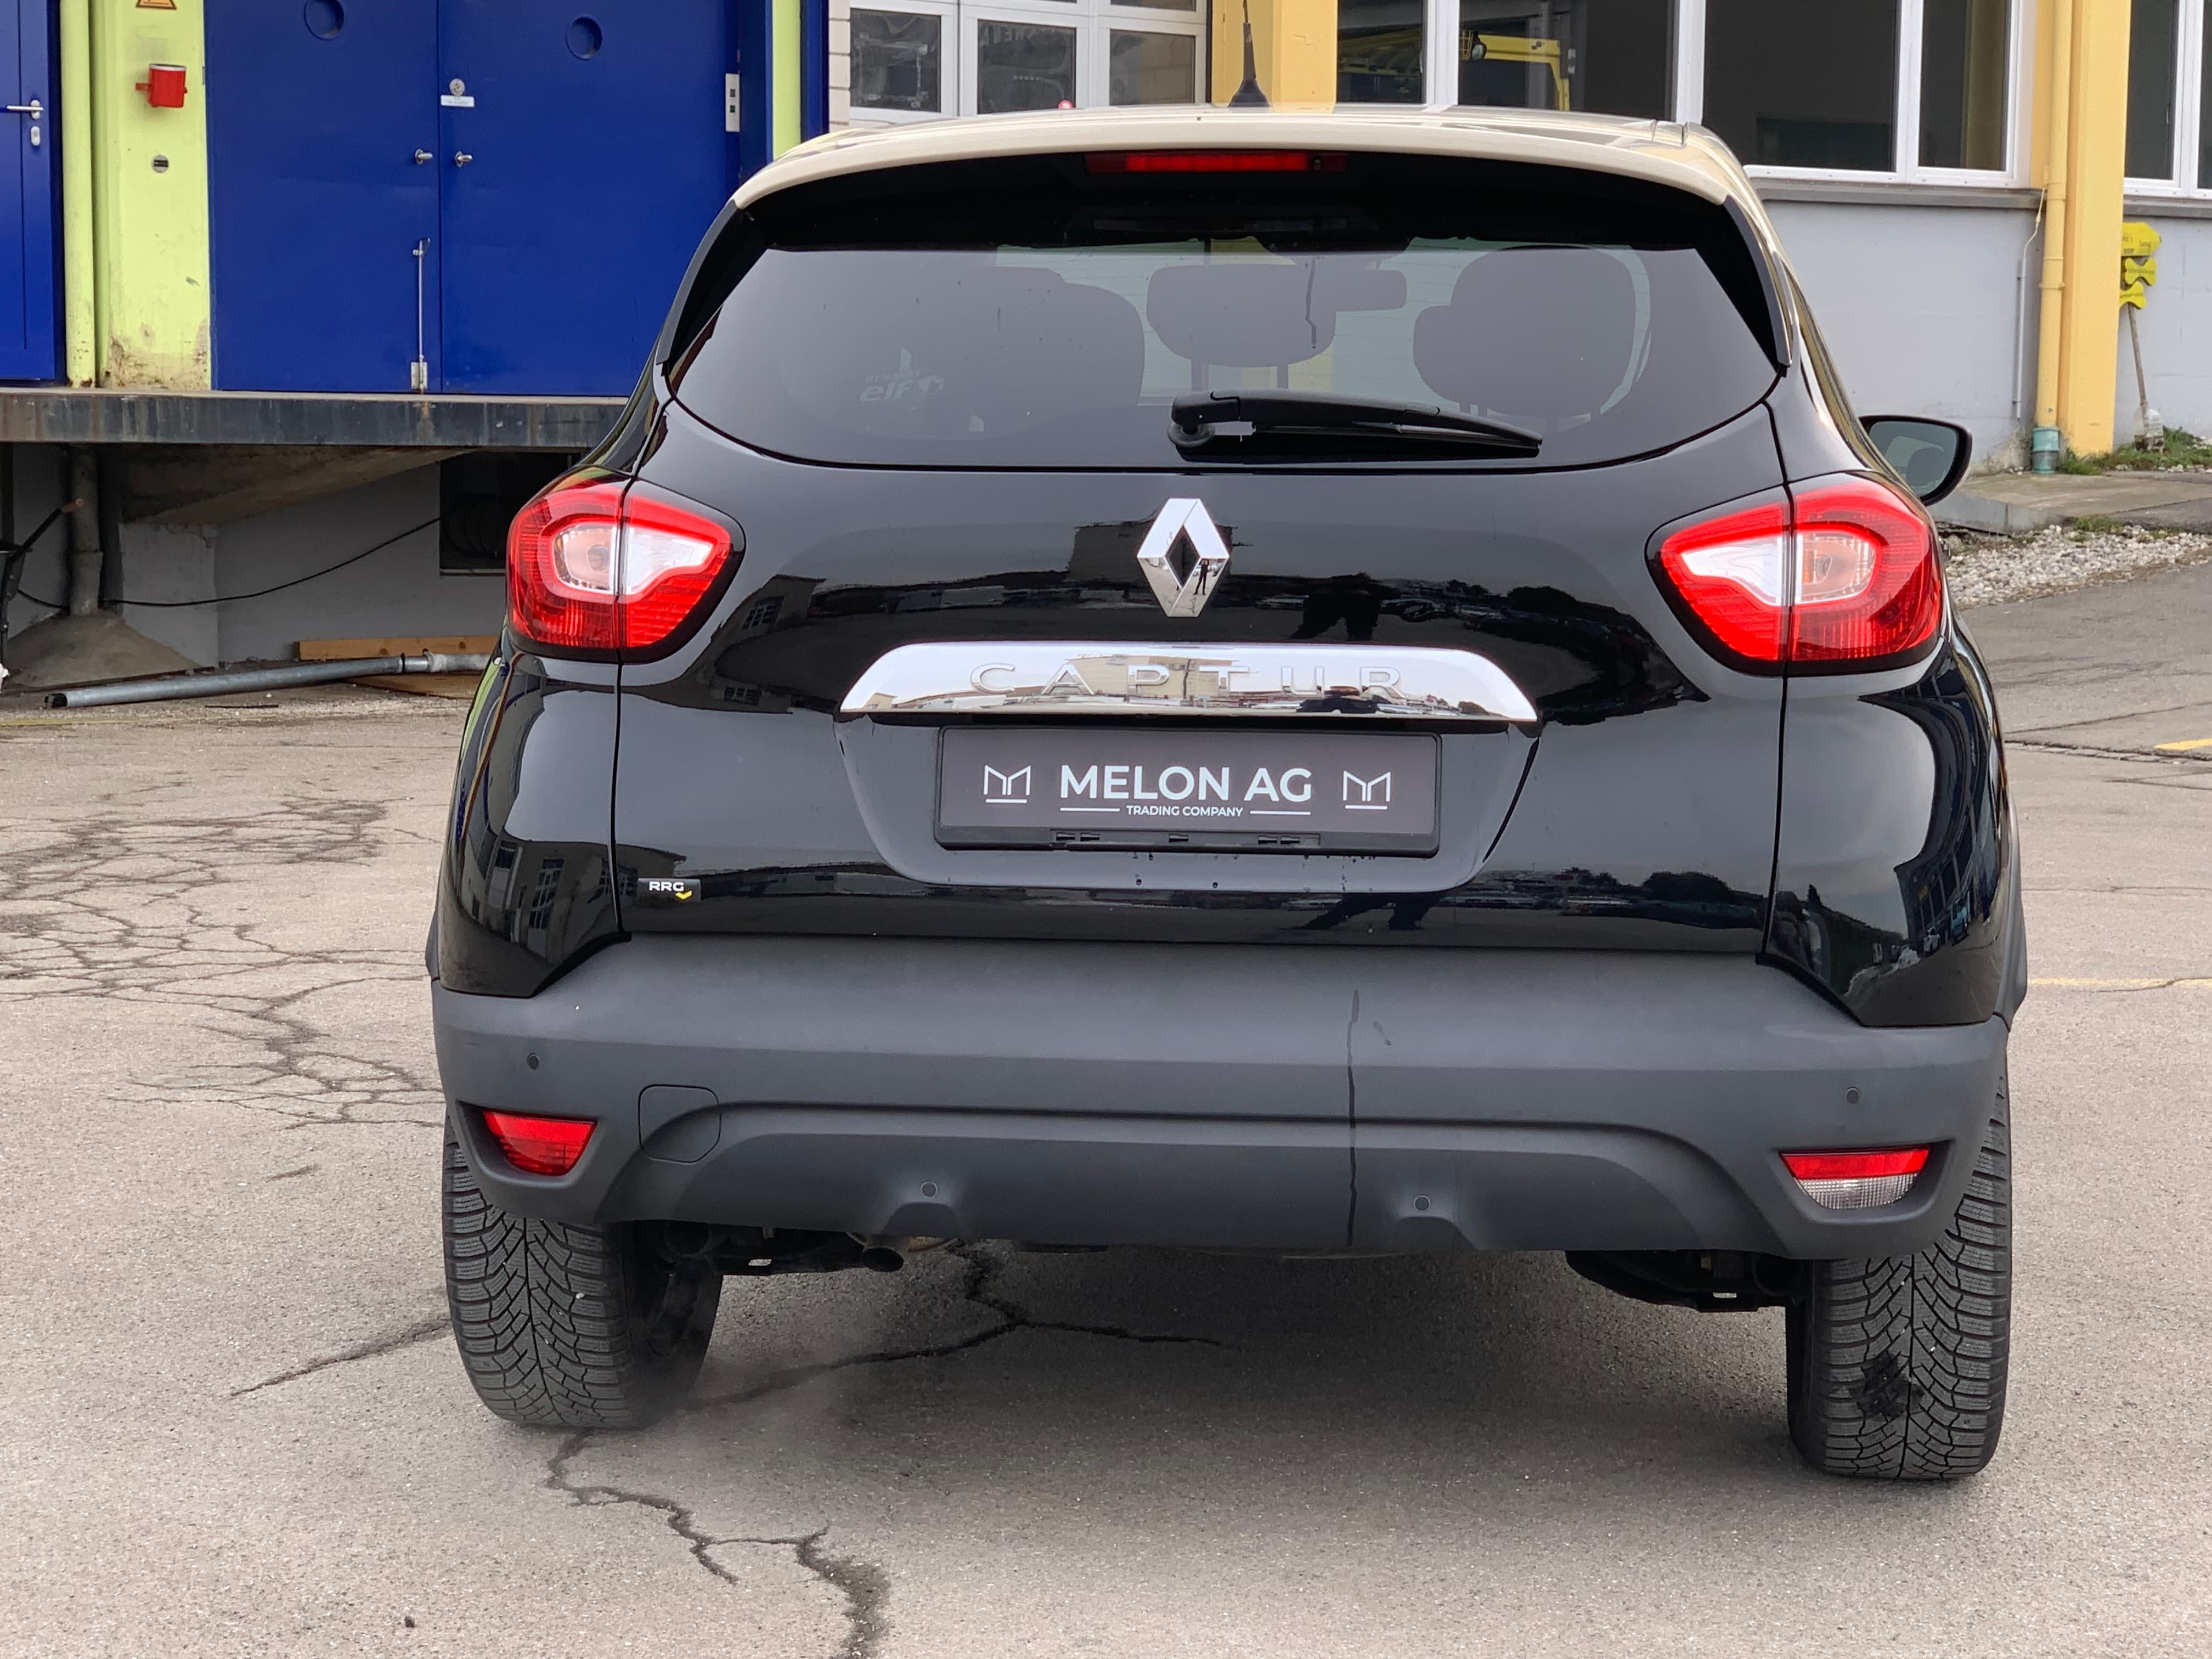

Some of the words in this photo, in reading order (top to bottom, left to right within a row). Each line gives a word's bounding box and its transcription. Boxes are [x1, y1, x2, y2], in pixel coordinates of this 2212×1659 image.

[970, 662, 1406, 699] CAPTUR
[1060, 765, 1229, 800] MELON
[1243, 767, 1312, 803] AG
[1126, 805, 1180, 816] TRADING
[1182, 806, 1244, 817] COMPANY
[649, 881, 685, 891] RRG
